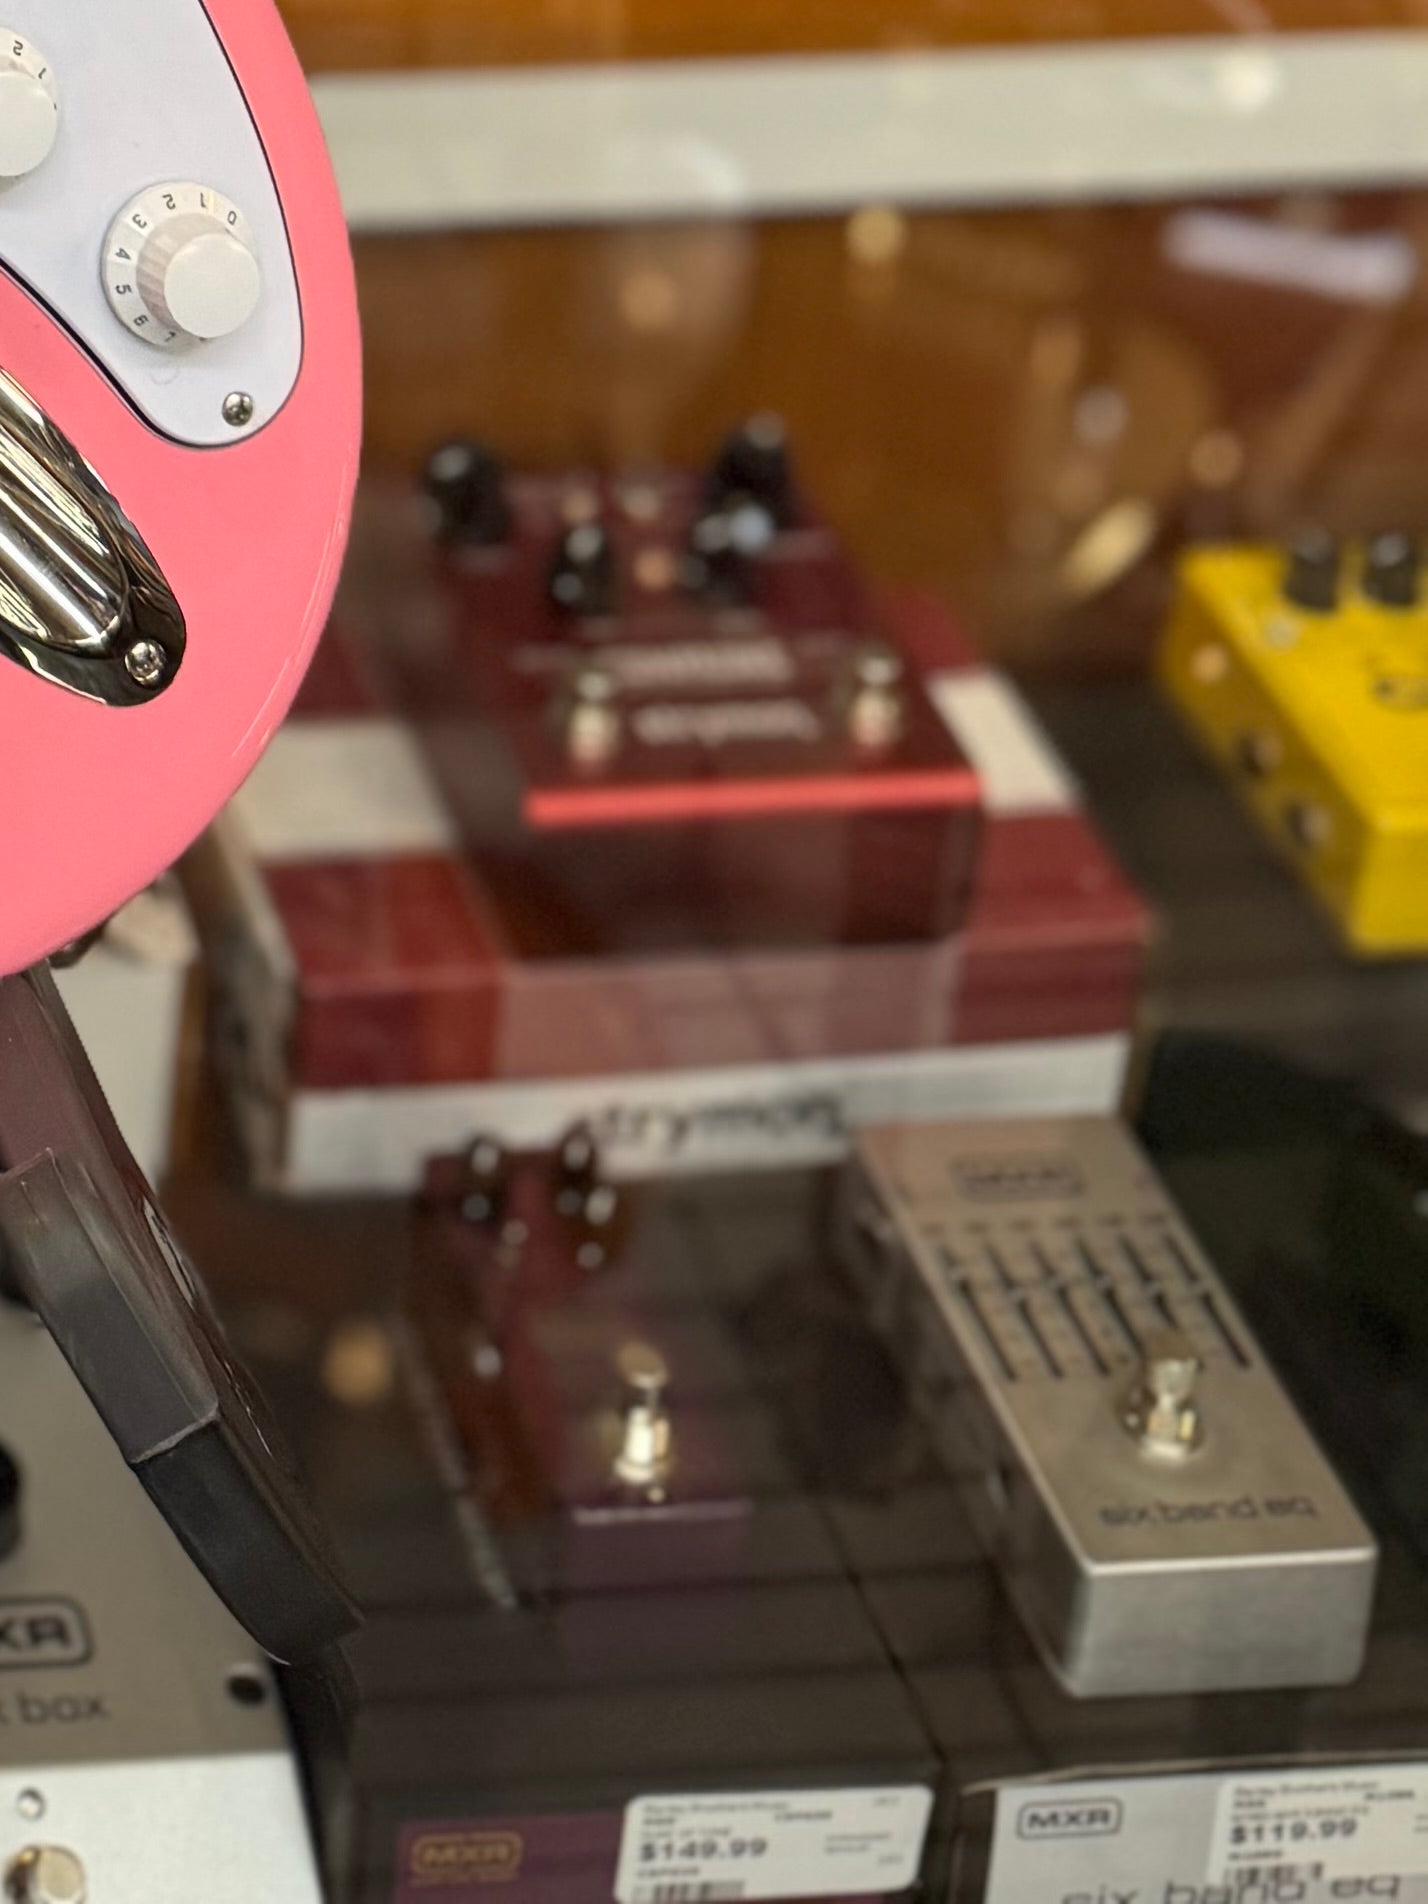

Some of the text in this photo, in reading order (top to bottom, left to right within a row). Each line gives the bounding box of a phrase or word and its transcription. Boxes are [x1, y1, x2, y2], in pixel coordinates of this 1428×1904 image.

[13, 40, 24, 56] 2
[162, 194, 176, 210] 2
[132, 214, 147, 229] 3
[227, 211, 238, 226] 0
[115, 248, 131, 260] 4
[115, 284, 132, 295] 5
[601, 1092, 844, 1158] trymon
[19, 1691, 111, 1725] box
[1027, 1805, 1112, 1829] MXR
[1231, 1818, 1357, 1844] $119.99
[640, 1837, 768, 1861] $149.99
[1330, 1874, 1402, 1900] eq
